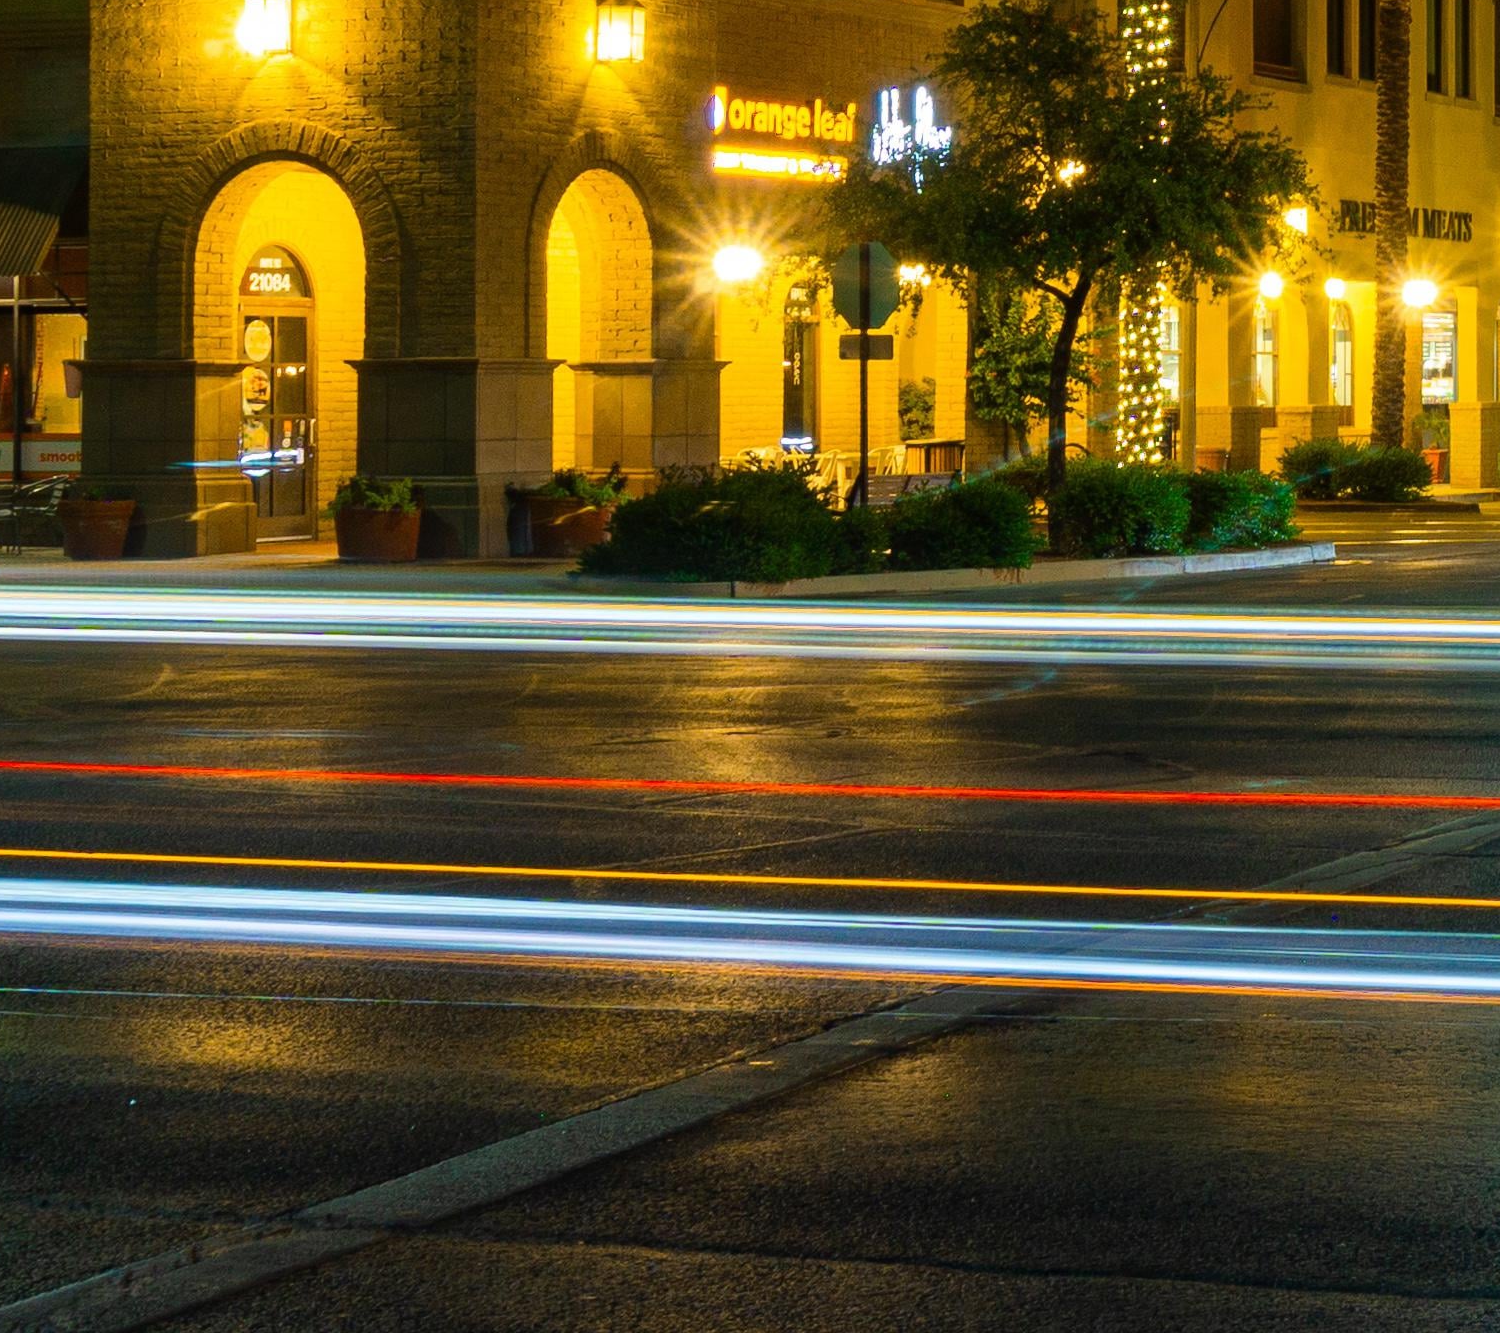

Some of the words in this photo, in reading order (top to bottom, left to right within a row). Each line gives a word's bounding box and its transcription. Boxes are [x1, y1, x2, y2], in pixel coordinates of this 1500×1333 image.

[728, 98, 811, 140] orange
[814, 98, 857, 142] leaf
[1338, 198, 1419, 237] PREM
[1422, 206, 1473, 243] MEATS
[249, 272, 291, 293] 21084
